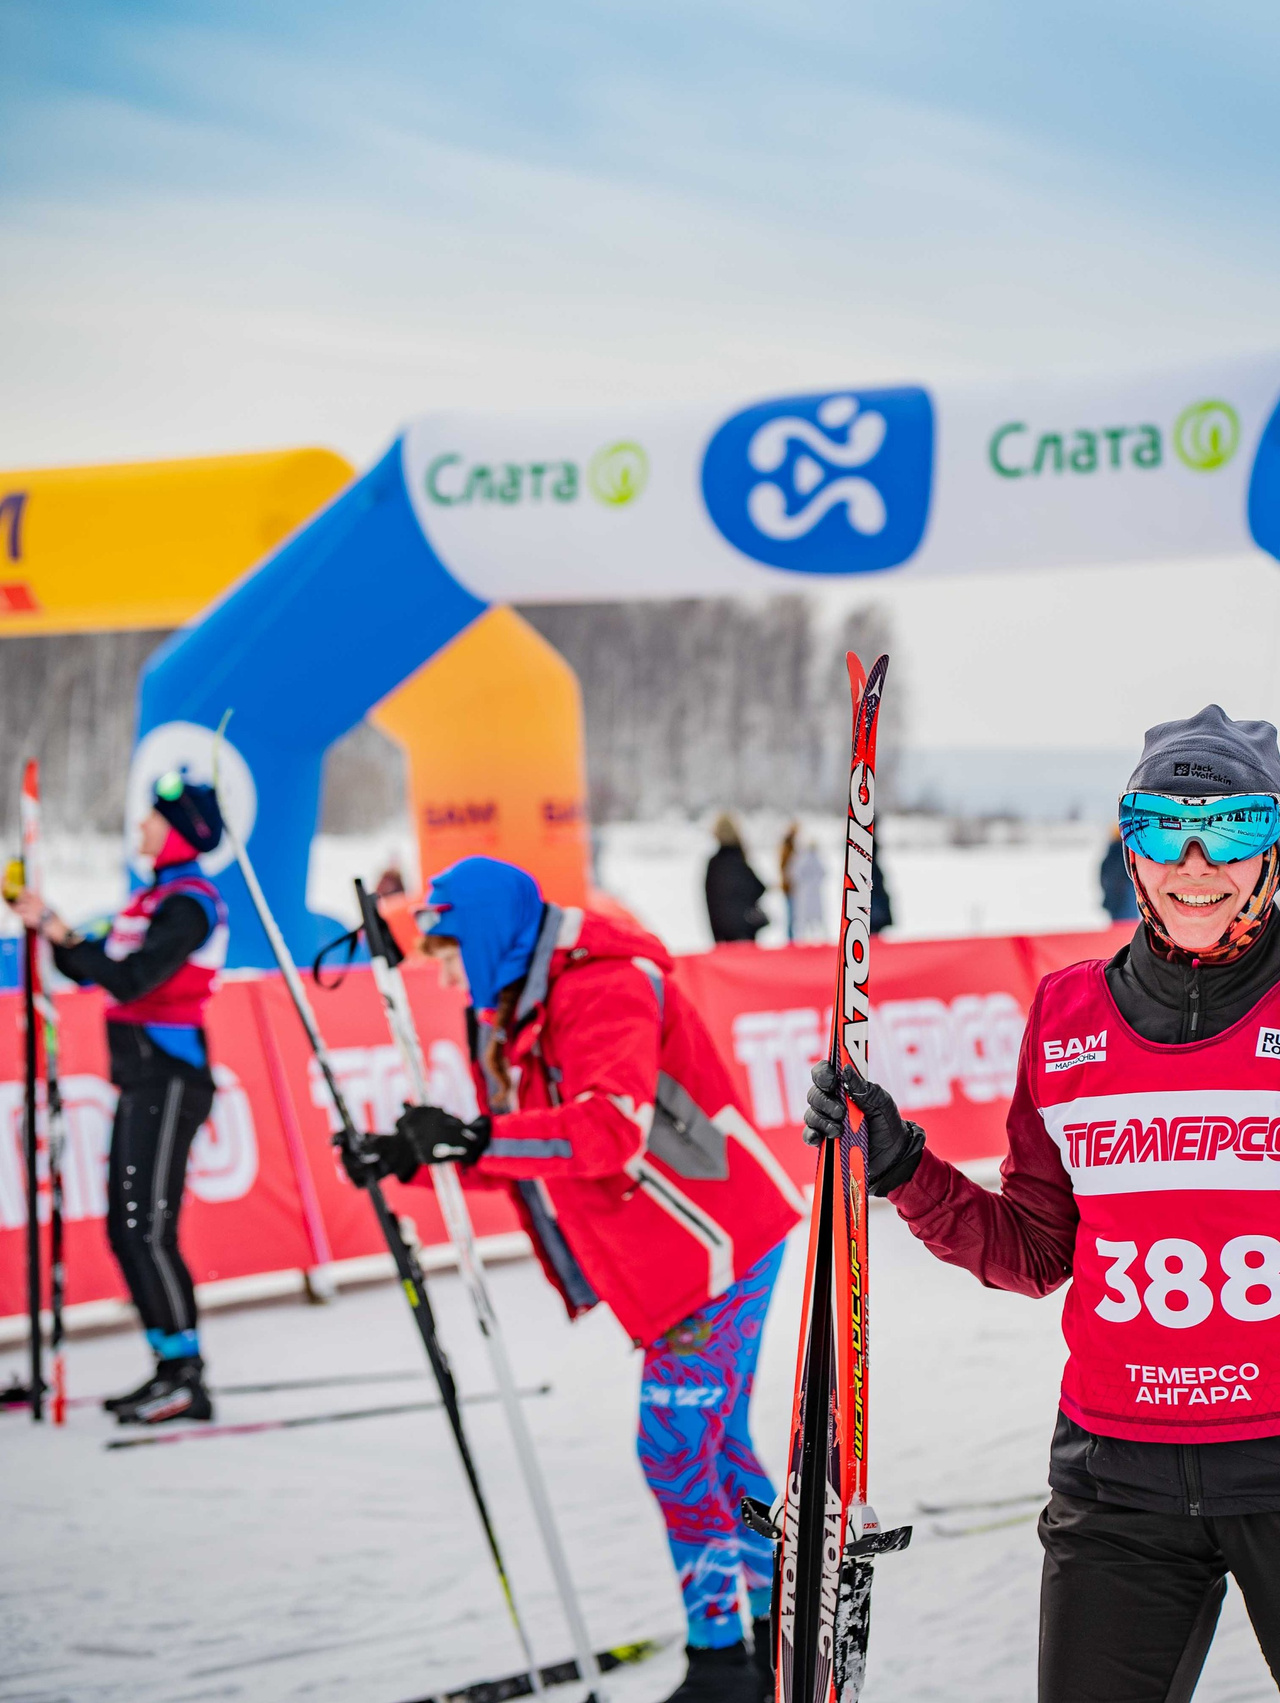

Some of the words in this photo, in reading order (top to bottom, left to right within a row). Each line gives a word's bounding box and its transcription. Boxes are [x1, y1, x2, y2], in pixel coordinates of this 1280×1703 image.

[989, 422, 1163, 479] Слата
[425, 454, 580, 506] Слата
[1191, 763, 1213, 773] Jack
[1191, 771, 1232, 786] Wolfskin
[1043, 1030, 1107, 1060] БАМ
[1125, 1362, 1260, 1385] ТЕМЕРСО
[1135, 1385, 1252, 1407] АНГАРА
[780, 1471, 802, 1649] ATOMIC
[817, 1480, 842, 1660] ATOMIC
